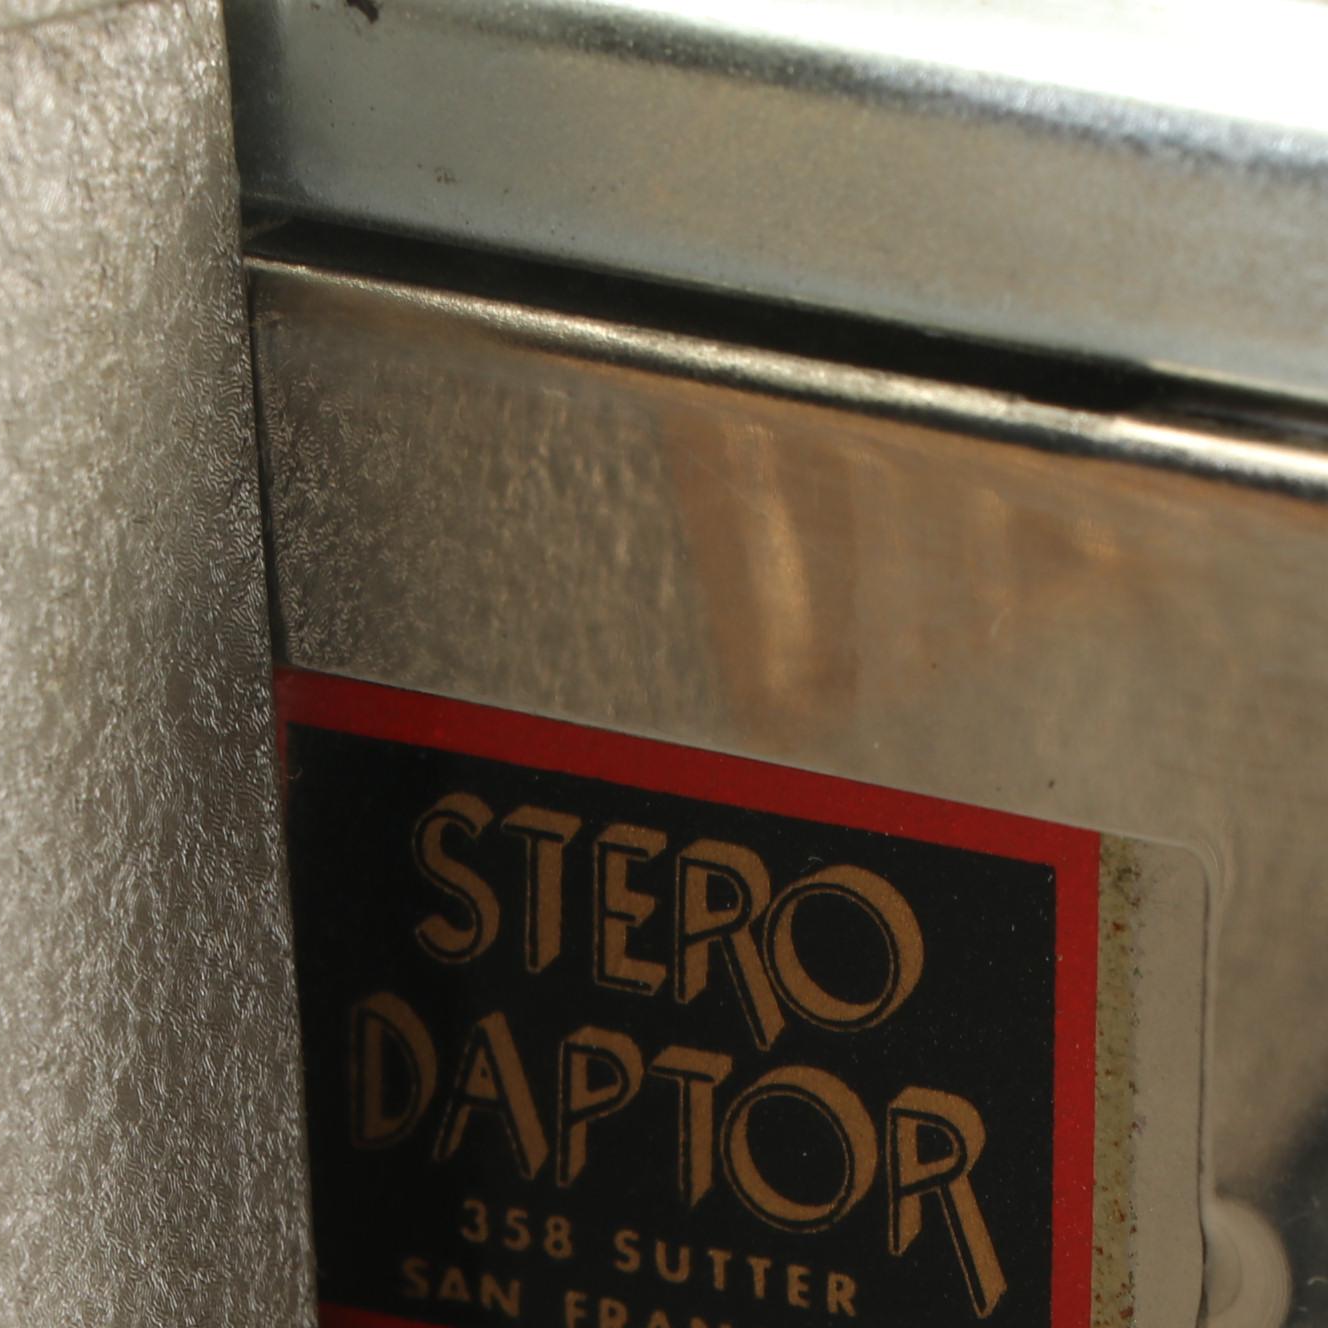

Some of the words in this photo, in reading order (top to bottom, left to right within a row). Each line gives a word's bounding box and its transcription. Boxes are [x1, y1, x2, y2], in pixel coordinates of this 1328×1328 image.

[414, 794, 924, 1050] STERO
[350, 992, 1007, 1318] DAPTOR
[401, 1257, 521, 1318] SAN
[462, 1200, 574, 1259] 358
[614, 1229, 858, 1317] SUTTER
